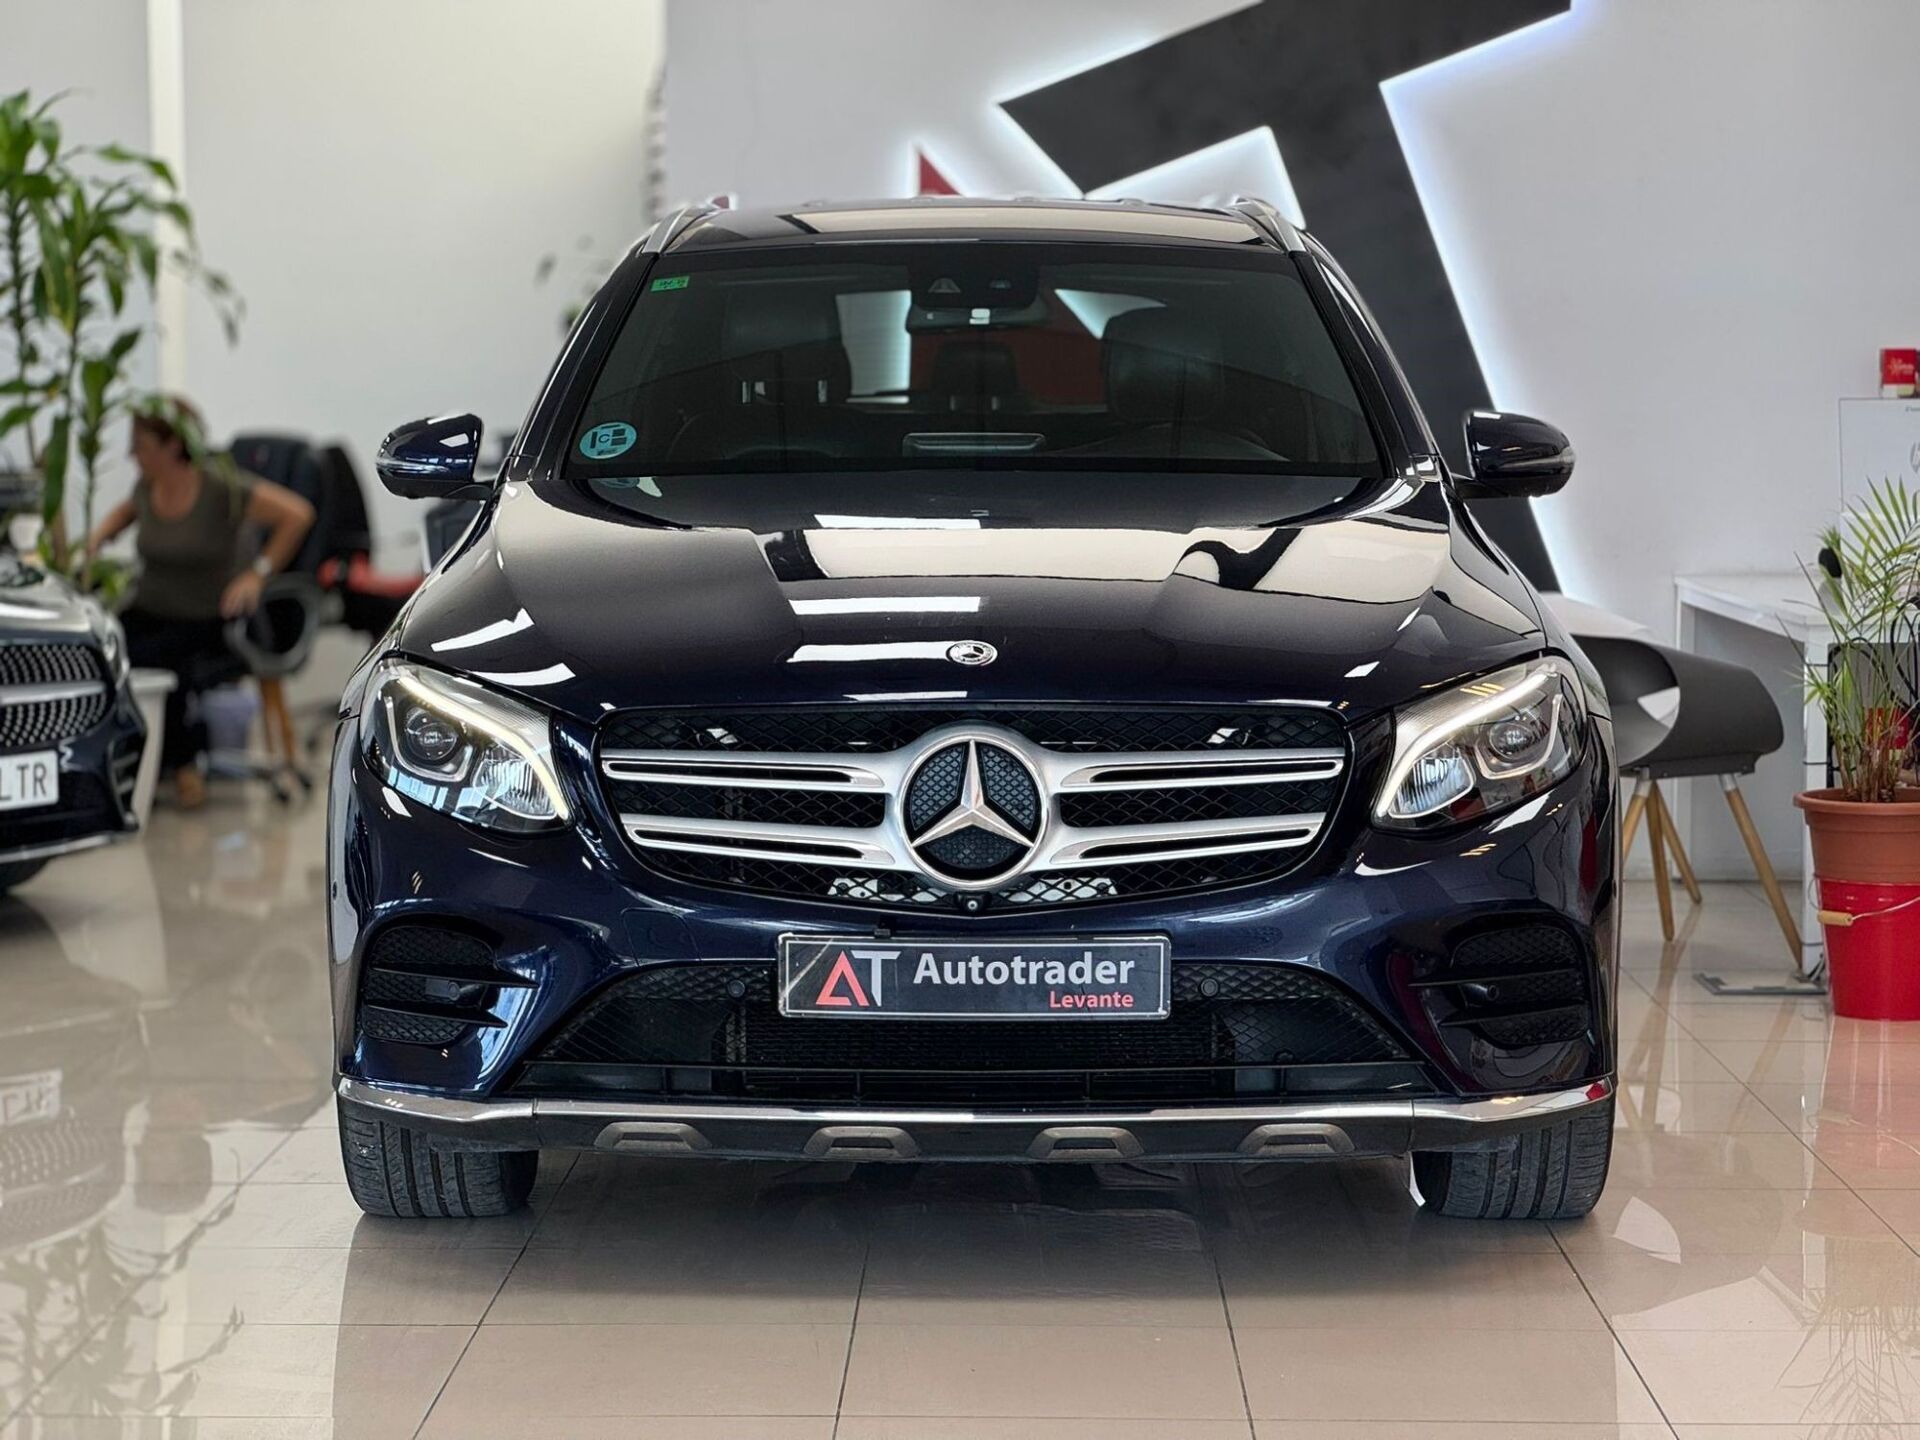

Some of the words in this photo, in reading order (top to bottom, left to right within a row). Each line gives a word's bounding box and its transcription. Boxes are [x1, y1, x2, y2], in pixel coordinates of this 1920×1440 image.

[815, 950, 901, 1007] AT
[913, 951, 1135, 985] Autotrader
[1049, 990, 1134, 1009] Levante
